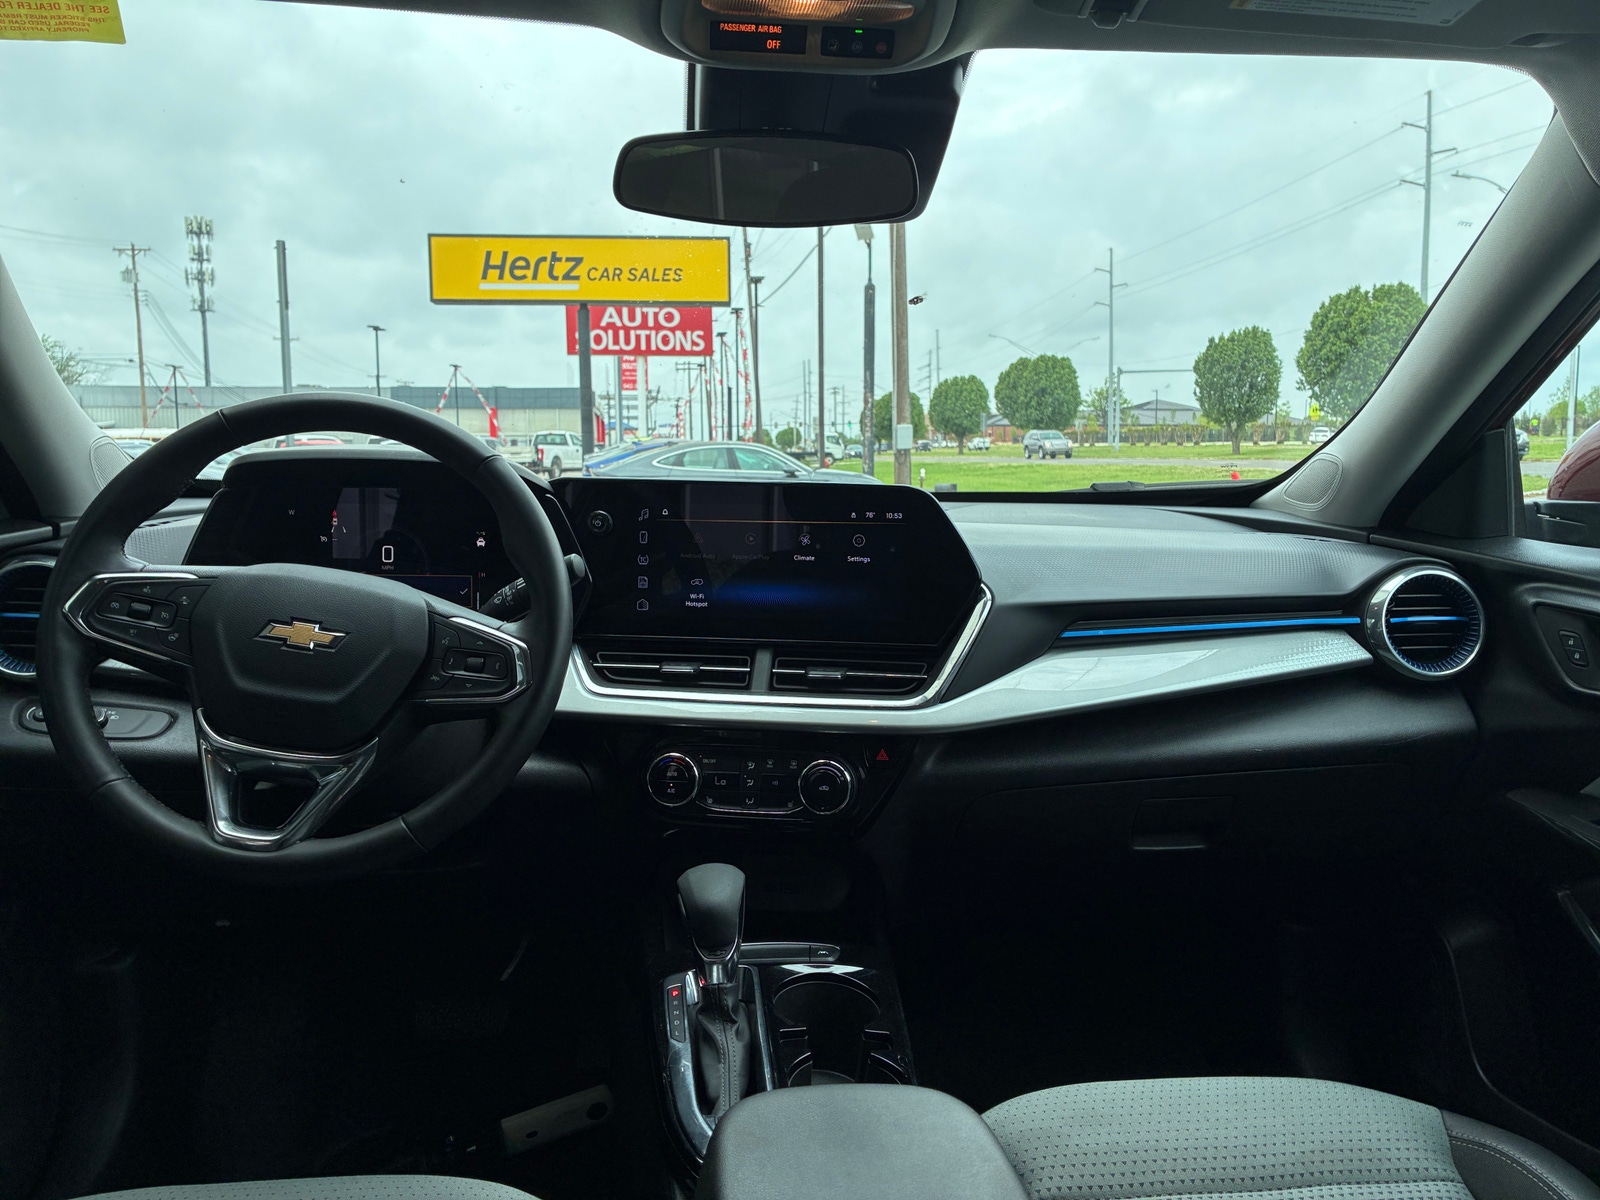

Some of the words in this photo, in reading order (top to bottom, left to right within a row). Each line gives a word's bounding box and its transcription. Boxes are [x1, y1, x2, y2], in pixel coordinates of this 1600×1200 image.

[719, 22, 756, 33] PASSENGER
[757, 24, 769, 33] AIR
[769, 25, 782, 34] BAG
[766, 39, 782, 50] OFF
[480, 250, 585, 282] Hertz
[587, 267, 622, 282] CAR
[627, 267, 684, 283] SALES
[600, 306, 681, 327] AUTO
[885, 512, 903, 520] 10:53
[381, 545, 394, 563] 0
[793, 554, 816, 562] Climate
[847, 555, 871, 564] Settings
[685, 600, 708, 609] Hotspot
